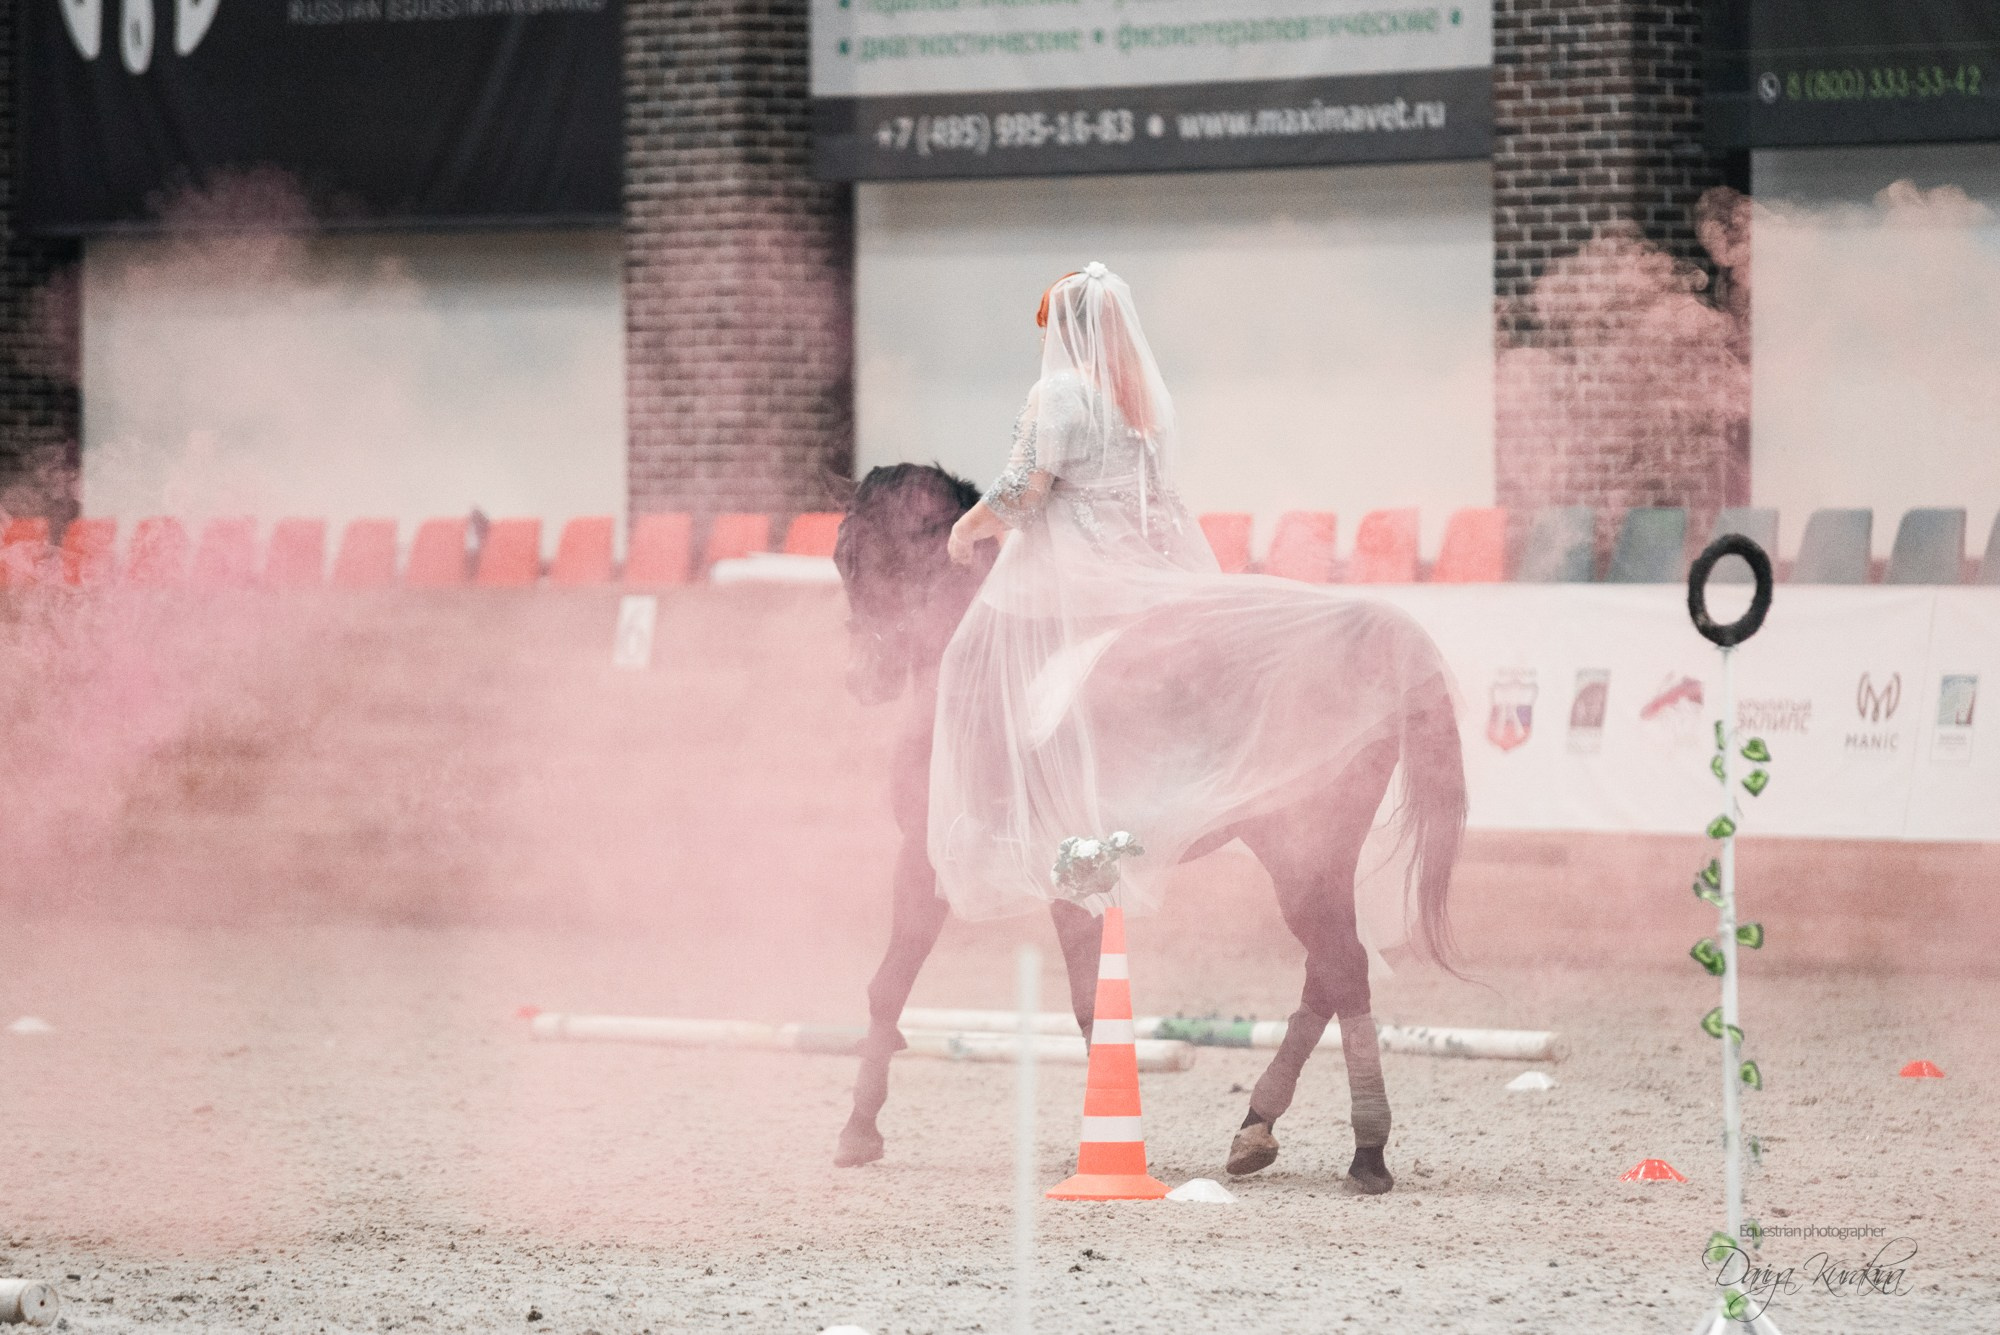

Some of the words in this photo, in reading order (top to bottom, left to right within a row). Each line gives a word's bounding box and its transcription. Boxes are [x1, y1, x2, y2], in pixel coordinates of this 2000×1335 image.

[875, 116, 914, 150] +7
[1176, 97, 1446, 139] www.maximavet.ru
[1845, 733, 1899, 750] MANIC
